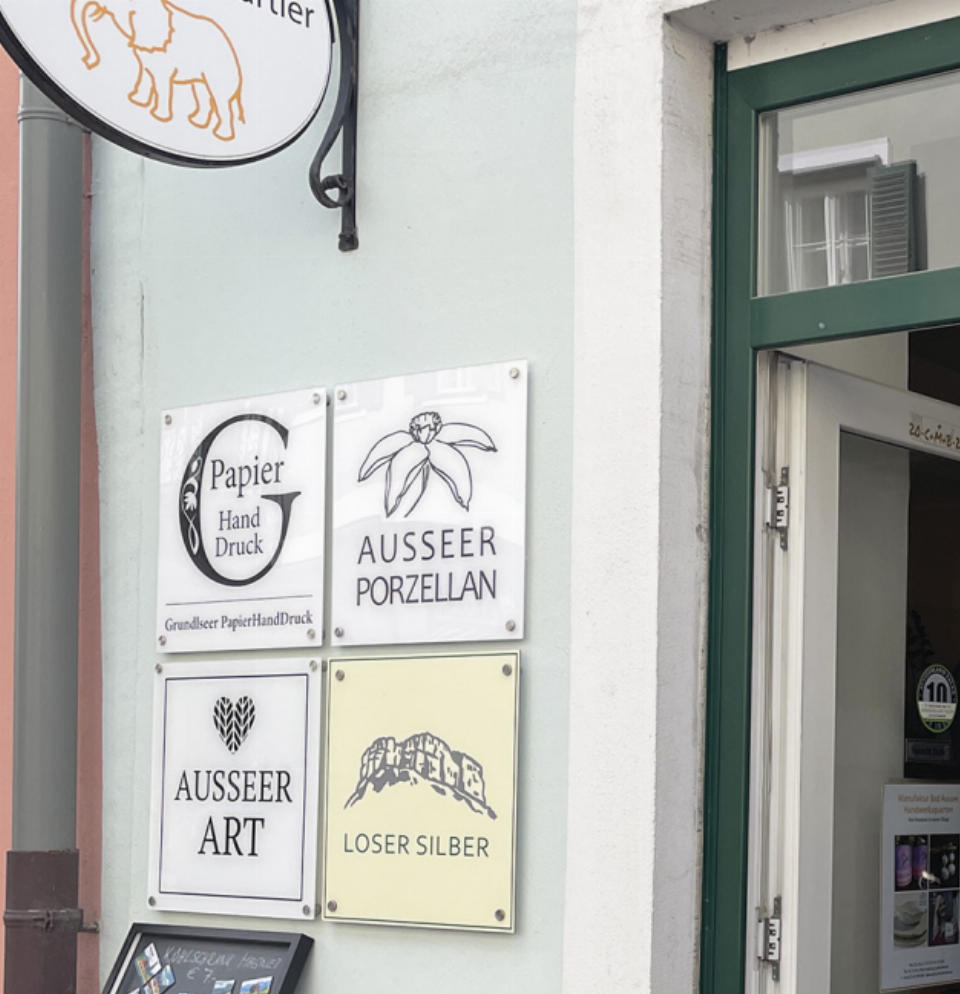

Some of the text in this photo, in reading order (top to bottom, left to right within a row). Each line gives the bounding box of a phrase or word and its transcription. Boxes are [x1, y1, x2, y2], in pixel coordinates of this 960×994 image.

[243, 0, 314, 27] tier
[210, 456, 285, 498] Papier
[218, 506, 260, 531] Hand
[215, 535, 264, 557] Druck
[358, 527, 496, 564] AUSSEER
[357, 570, 496, 606] PORZELLAN
[165, 610, 313, 632] Grundlseer PapierHandDruck
[175, 770, 292, 802] AUSSEER
[198, 816, 264, 856] ART
[344, 833, 489, 857] LOSER SILBER
